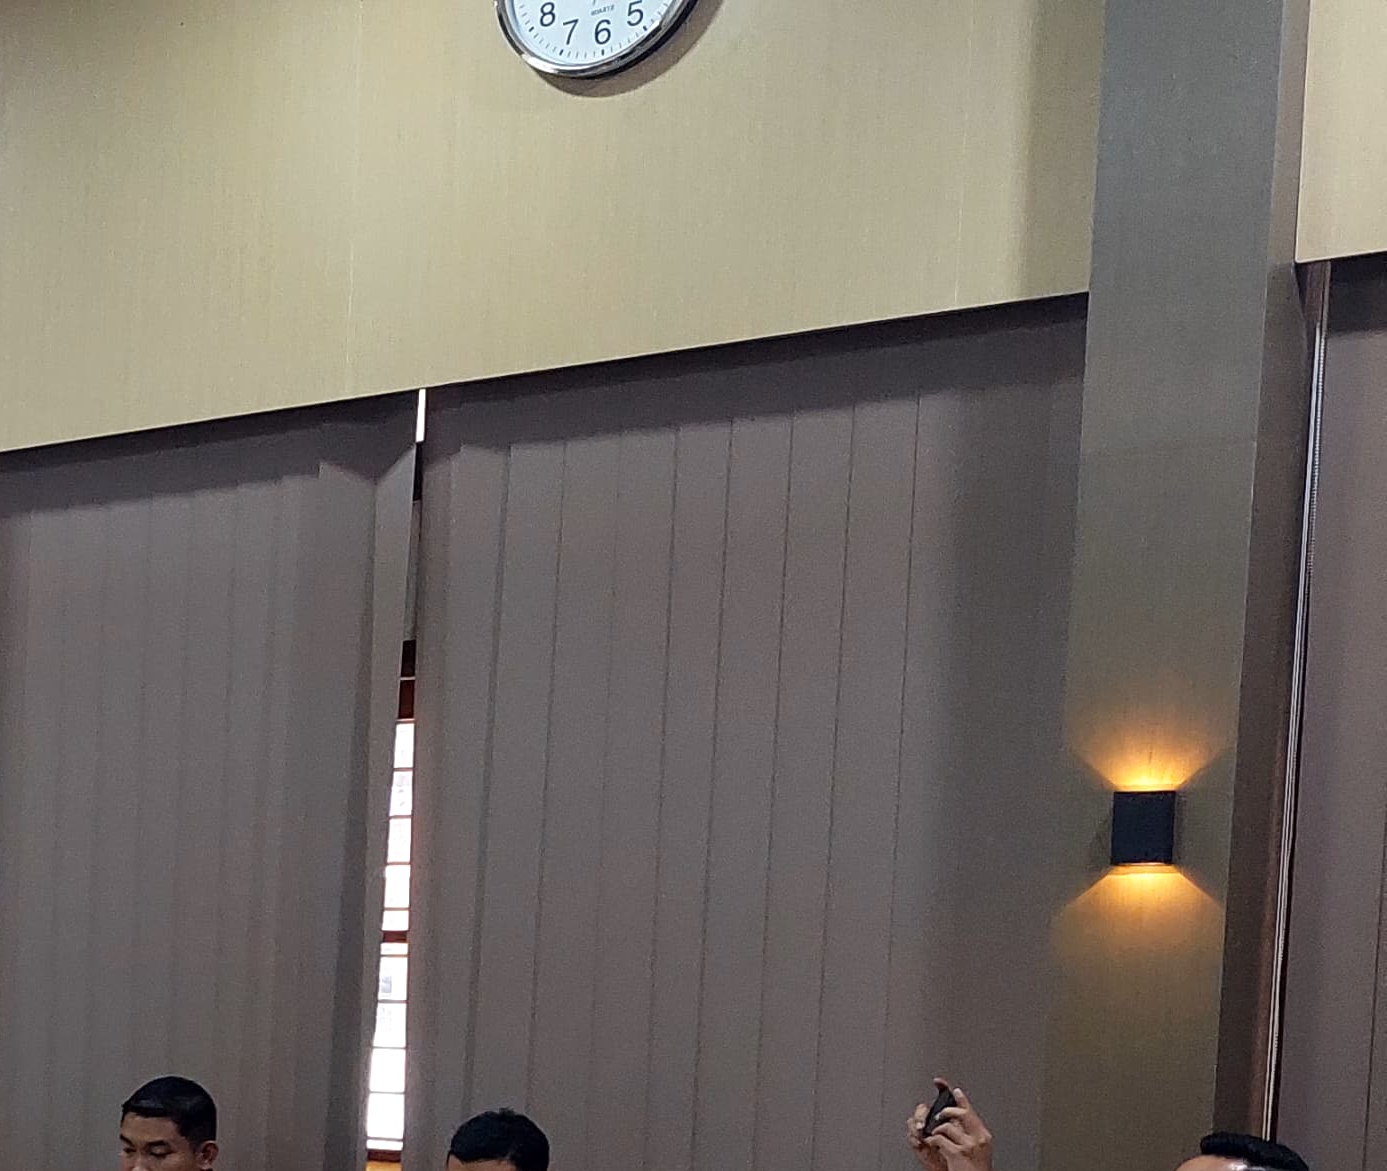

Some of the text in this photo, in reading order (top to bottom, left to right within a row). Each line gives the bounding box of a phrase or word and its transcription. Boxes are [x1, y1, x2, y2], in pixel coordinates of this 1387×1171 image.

[539, 1, 556, 28] 8
[627, 0, 645, 27] 5
[562, 18, 580, 46] 7
[594, 19, 612, 45] 6
